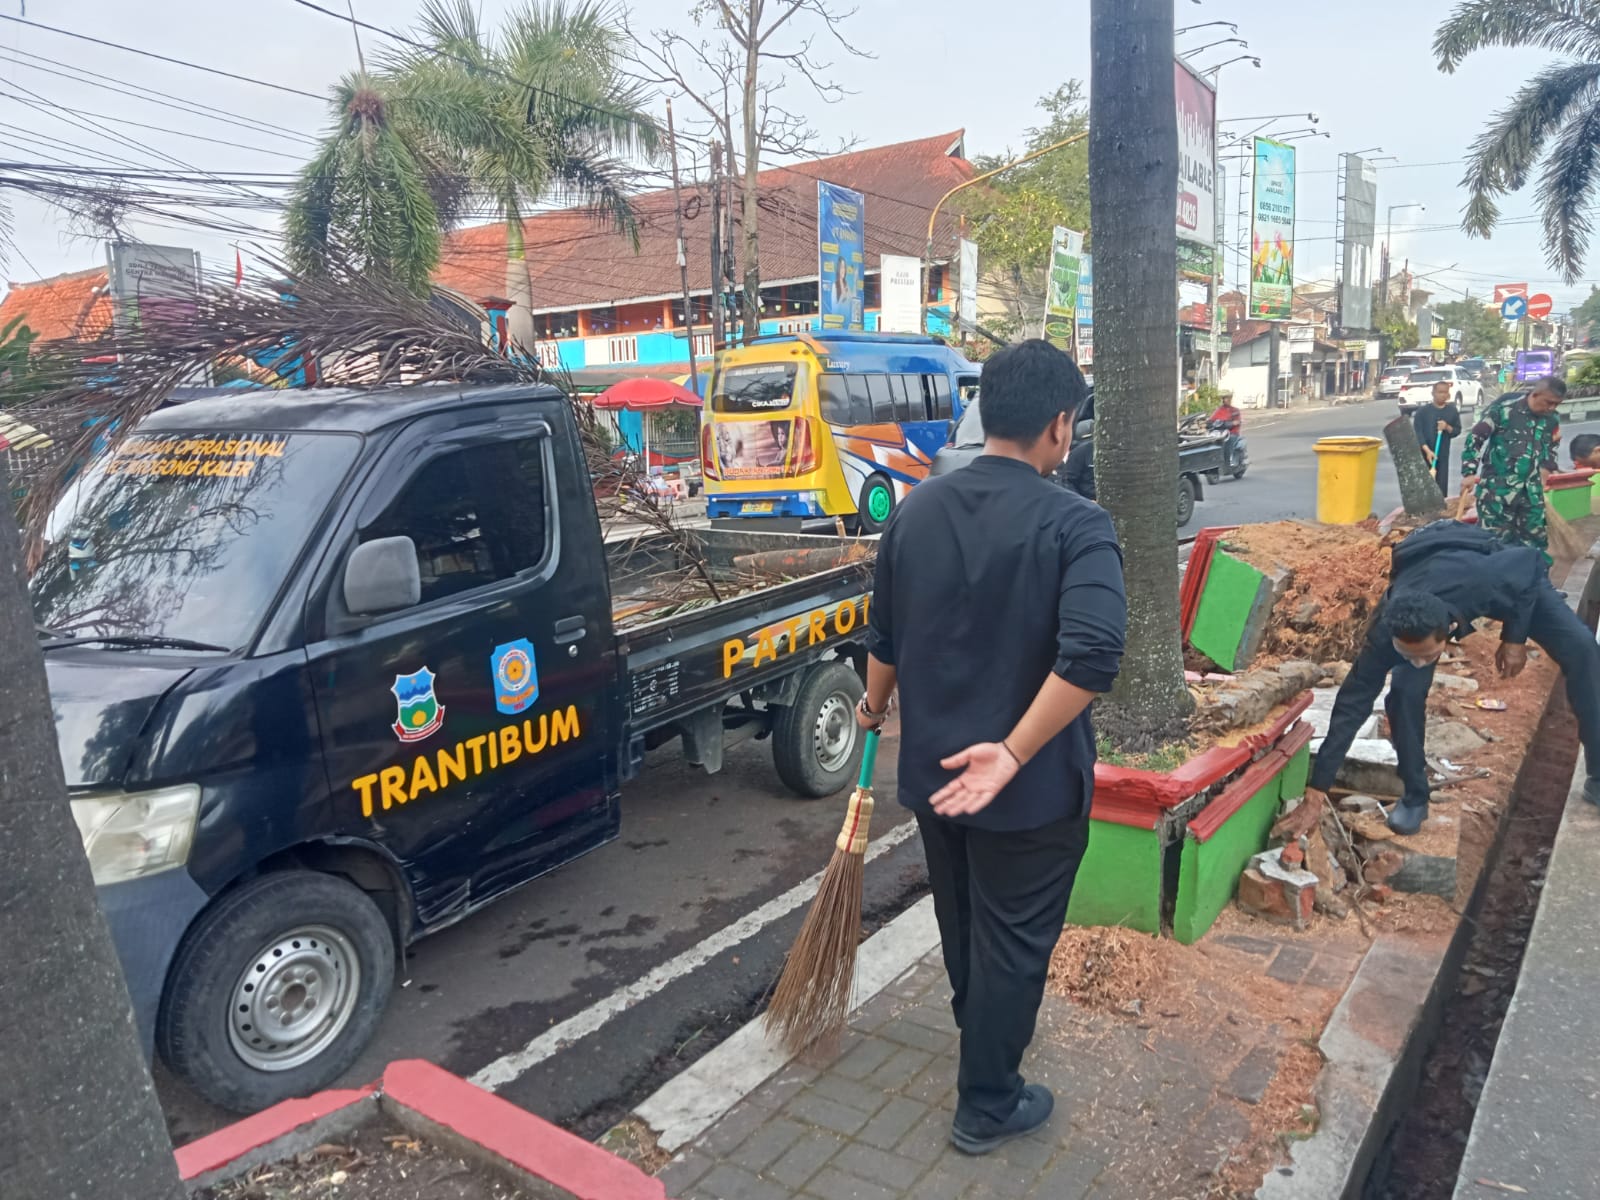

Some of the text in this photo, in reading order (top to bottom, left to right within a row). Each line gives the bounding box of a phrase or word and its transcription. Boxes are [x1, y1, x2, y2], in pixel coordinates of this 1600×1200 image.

[1178, 151, 1212, 194] AILABLE
[826, 359, 850, 370] Luxury
[174, 439, 286, 457] OPERASIONAL
[196, 460, 254, 477] KALER
[352, 704, 581, 818] TRANTIBUM
